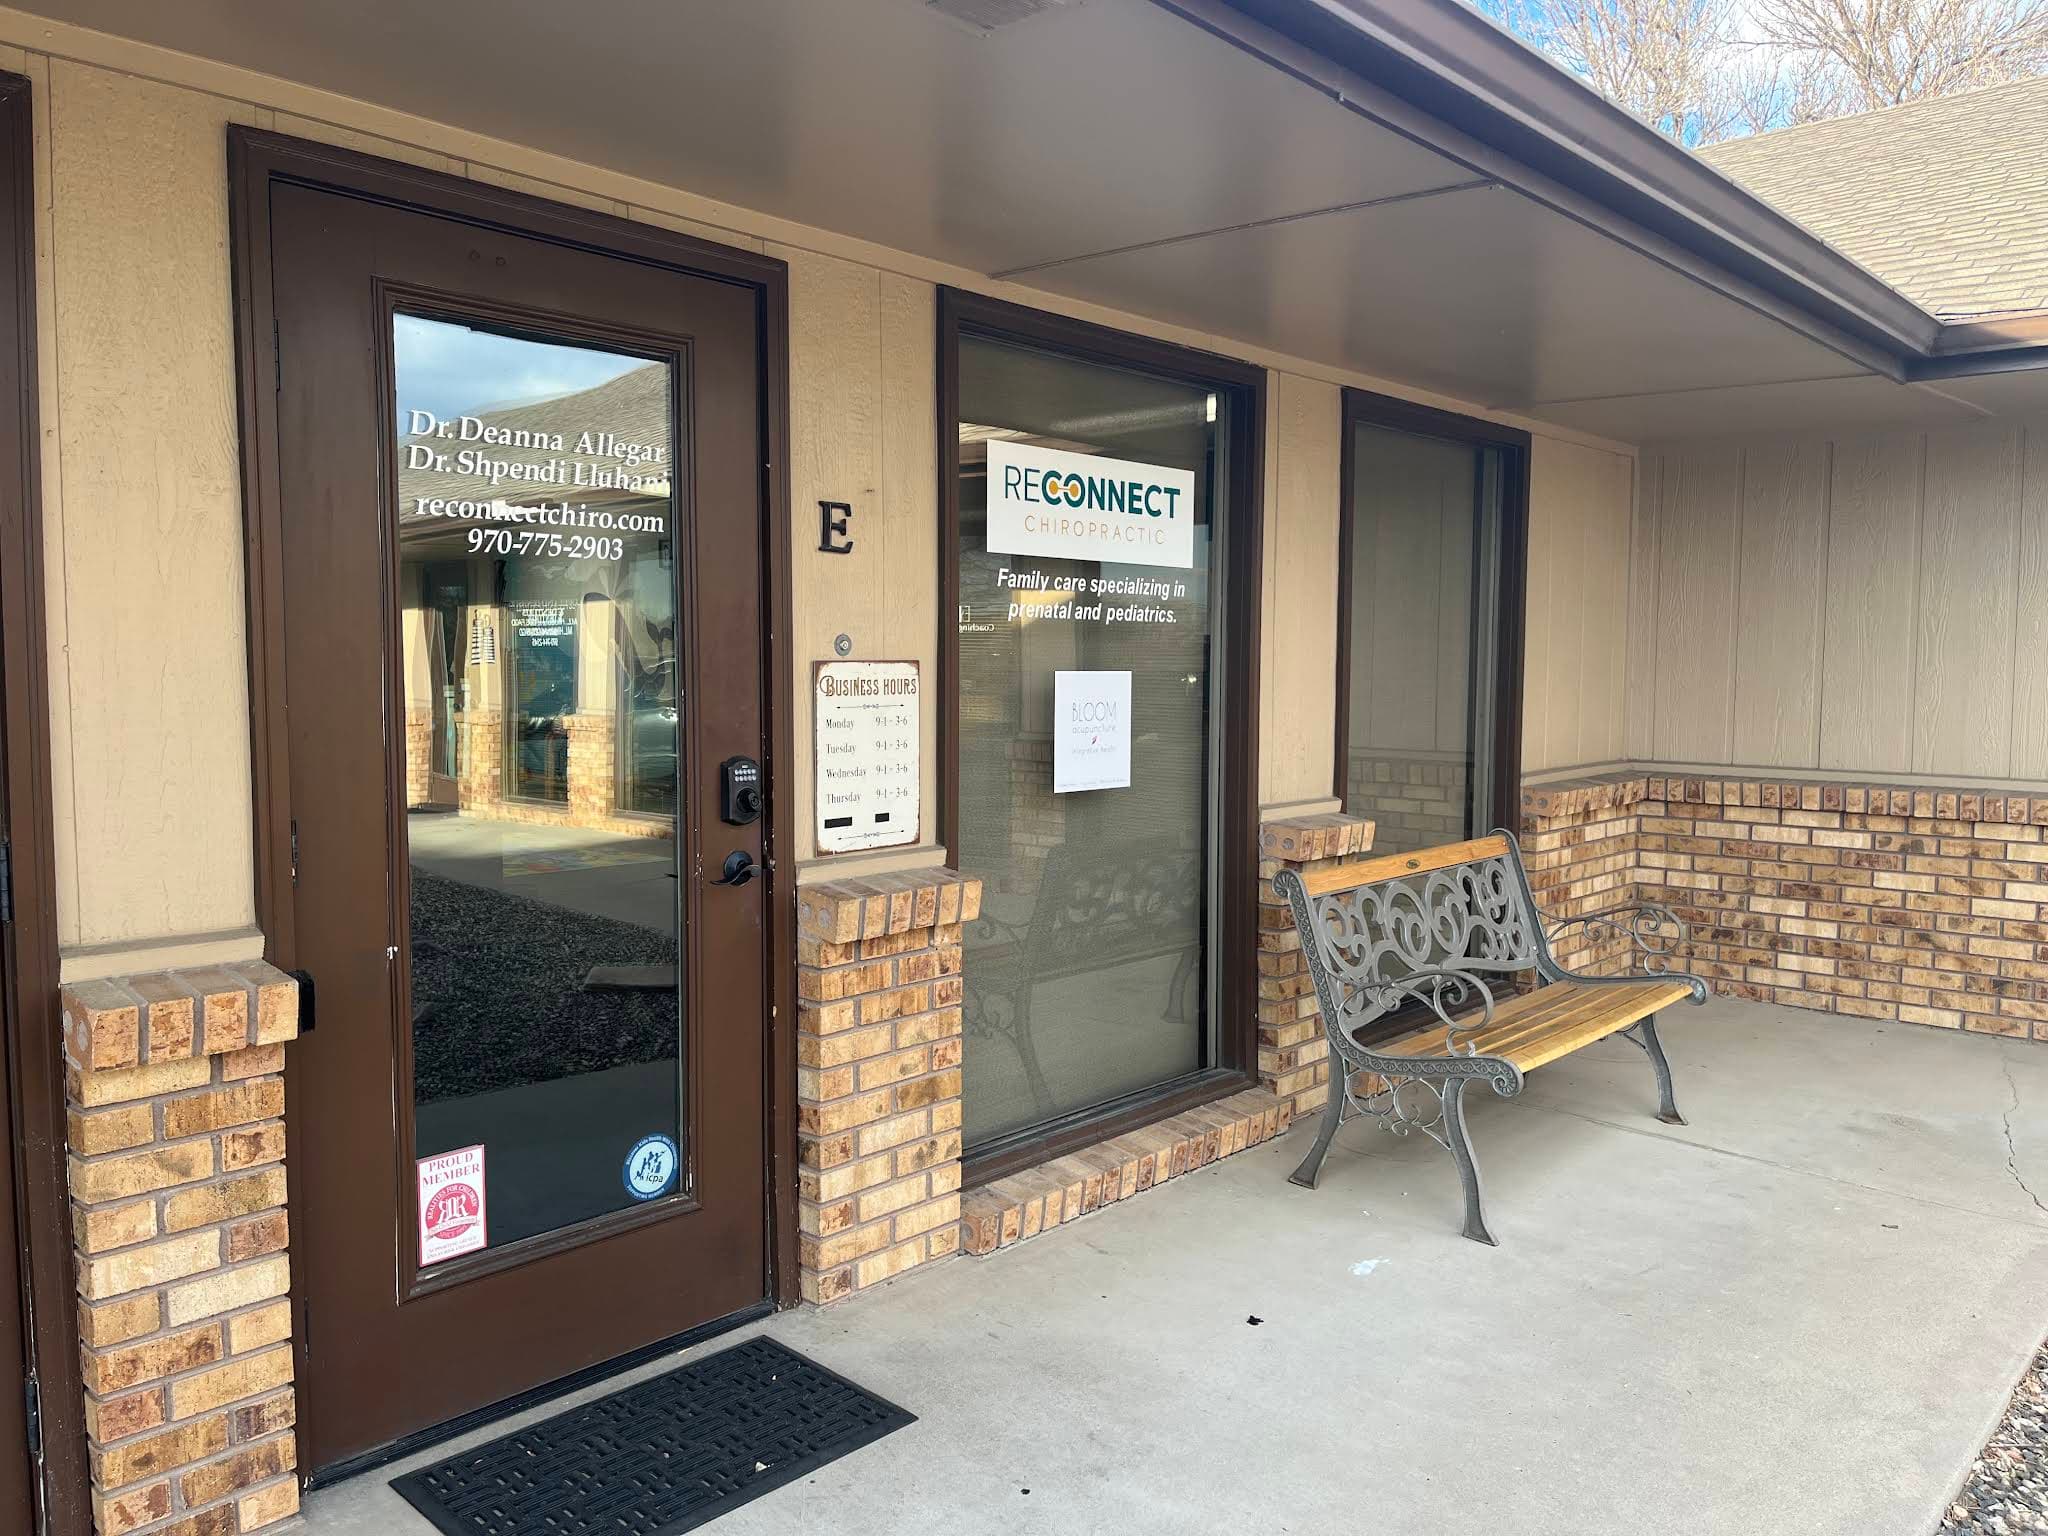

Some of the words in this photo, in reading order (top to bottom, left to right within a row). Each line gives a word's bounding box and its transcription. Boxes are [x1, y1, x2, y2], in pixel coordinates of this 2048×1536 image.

[459, 416, 562, 451] Deanna
[574, 431, 665, 467] Allegar
[408, 444, 452, 473] Dr.
[457, 450, 566, 486] Shpendi
[1005, 464, 1181, 519] RECONNECT
[415, 497, 665, 533] reconnectchiro.com
[818, 500, 854, 554] E
[1024, 515, 1165, 545] CHIROPRACTIC
[467, 527, 624, 561] 970-775-2903
[997, 567, 1049, 593] Family
[1053, 576, 1087, 592] care
[1090, 576, 1170, 601] specializing
[1174, 580, 1186, 598] in
[1008, 601, 1072, 621] prenatal
[1074, 602, 1102, 621] and
[1105, 603, 1177, 625] pediatrics.
[819, 675, 880, 697] BUSINESS
[883, 678, 917, 696] HOURS
[1072, 701, 1117, 722] BLOOM
[825, 718, 855, 731] Monday
[826, 742, 857, 756] Tuesday
[826, 766, 867, 779] Wednesday
[826, 792, 862, 805] Thursday
[429, 1152, 474, 1172] PROUD
[423, 1163, 480, 1186] MEMBER
